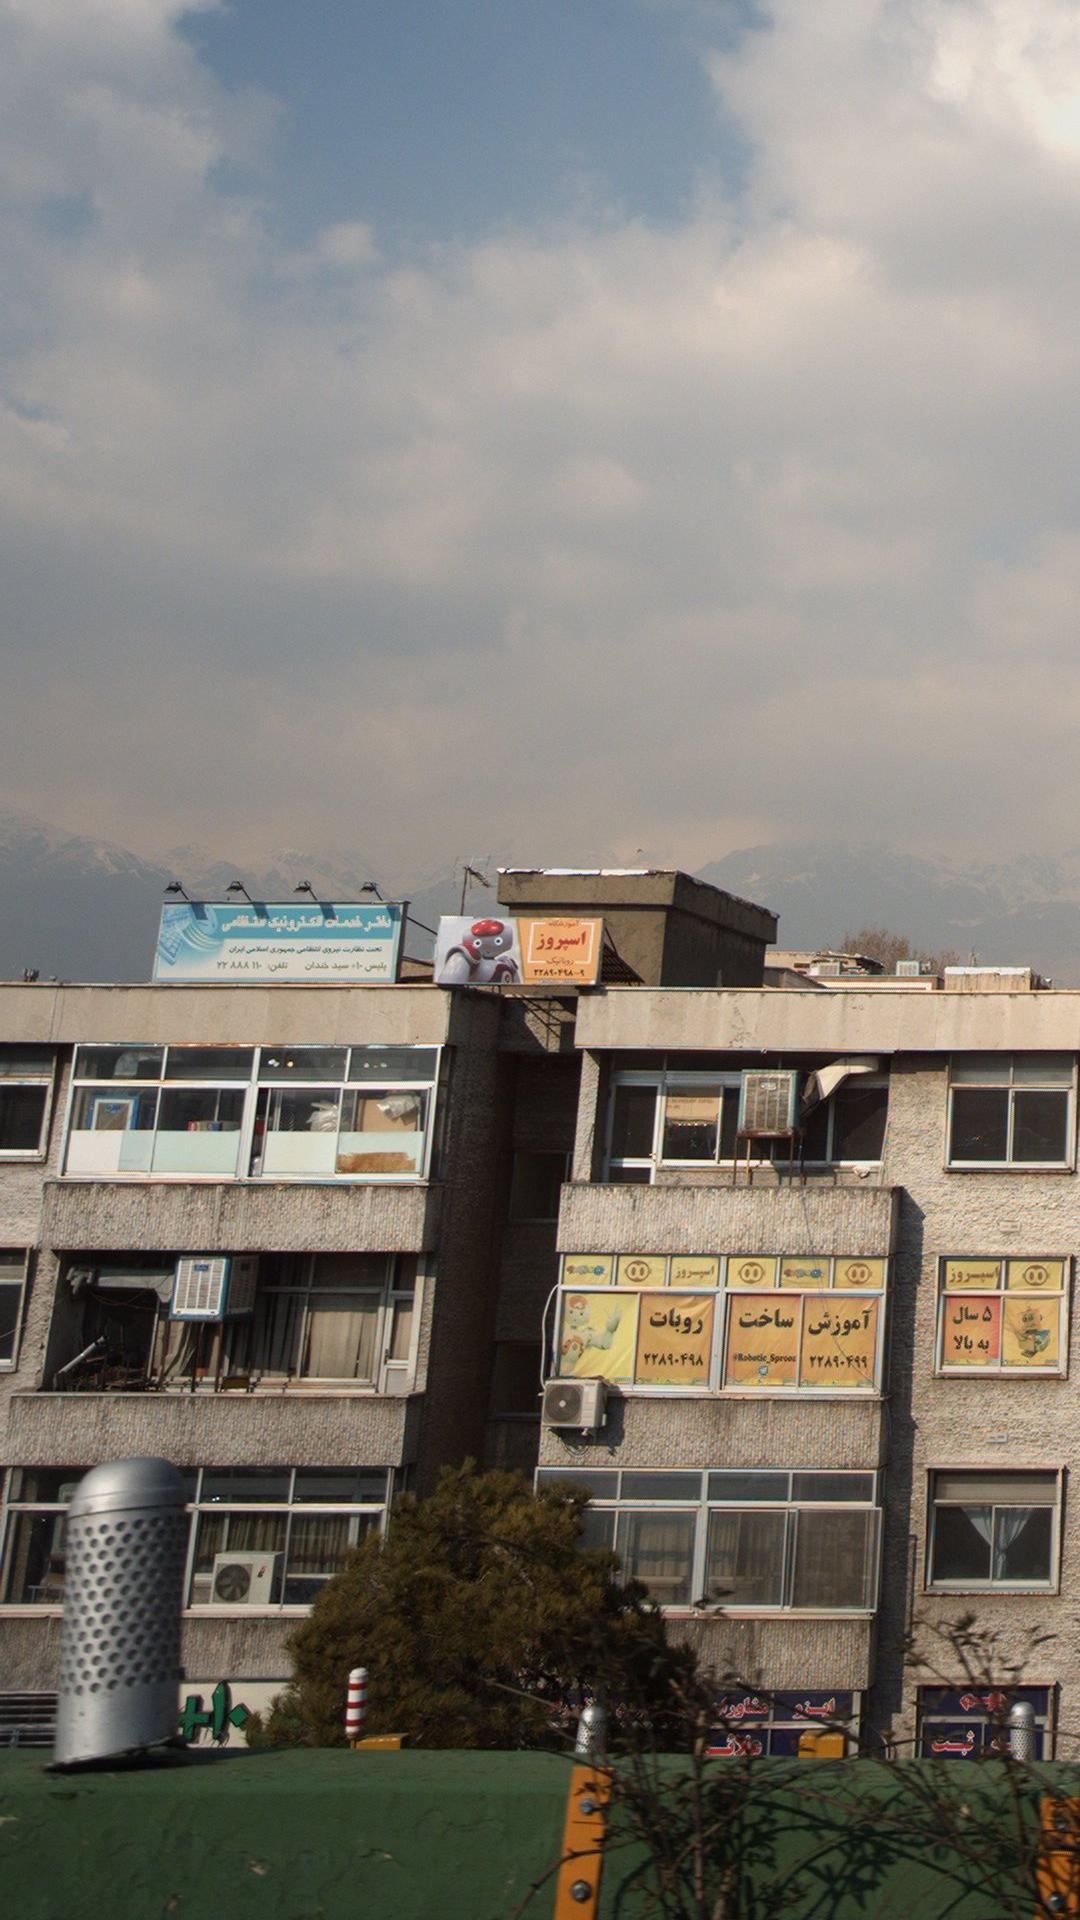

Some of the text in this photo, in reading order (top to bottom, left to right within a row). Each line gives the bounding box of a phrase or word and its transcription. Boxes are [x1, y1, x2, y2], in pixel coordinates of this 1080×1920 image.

[324, 915, 363, 928] خدمات
[364, 915, 391, 932] دفتر
[536, 930, 587, 951] اسپروز
[365, 961, 387, 972] پلیس
[649, 1307, 872, 1336] آموزش ساخت روبات
[952, 1305, 993, 1324] ۵ سال
[953, 1335, 990, 1354] به بالا
[644, 1352, 704, 1366] ۲۲۸۹۰۴۹۸
[809, 1355, 868, 1369] ۲۲۸۹۰۴۹۹
